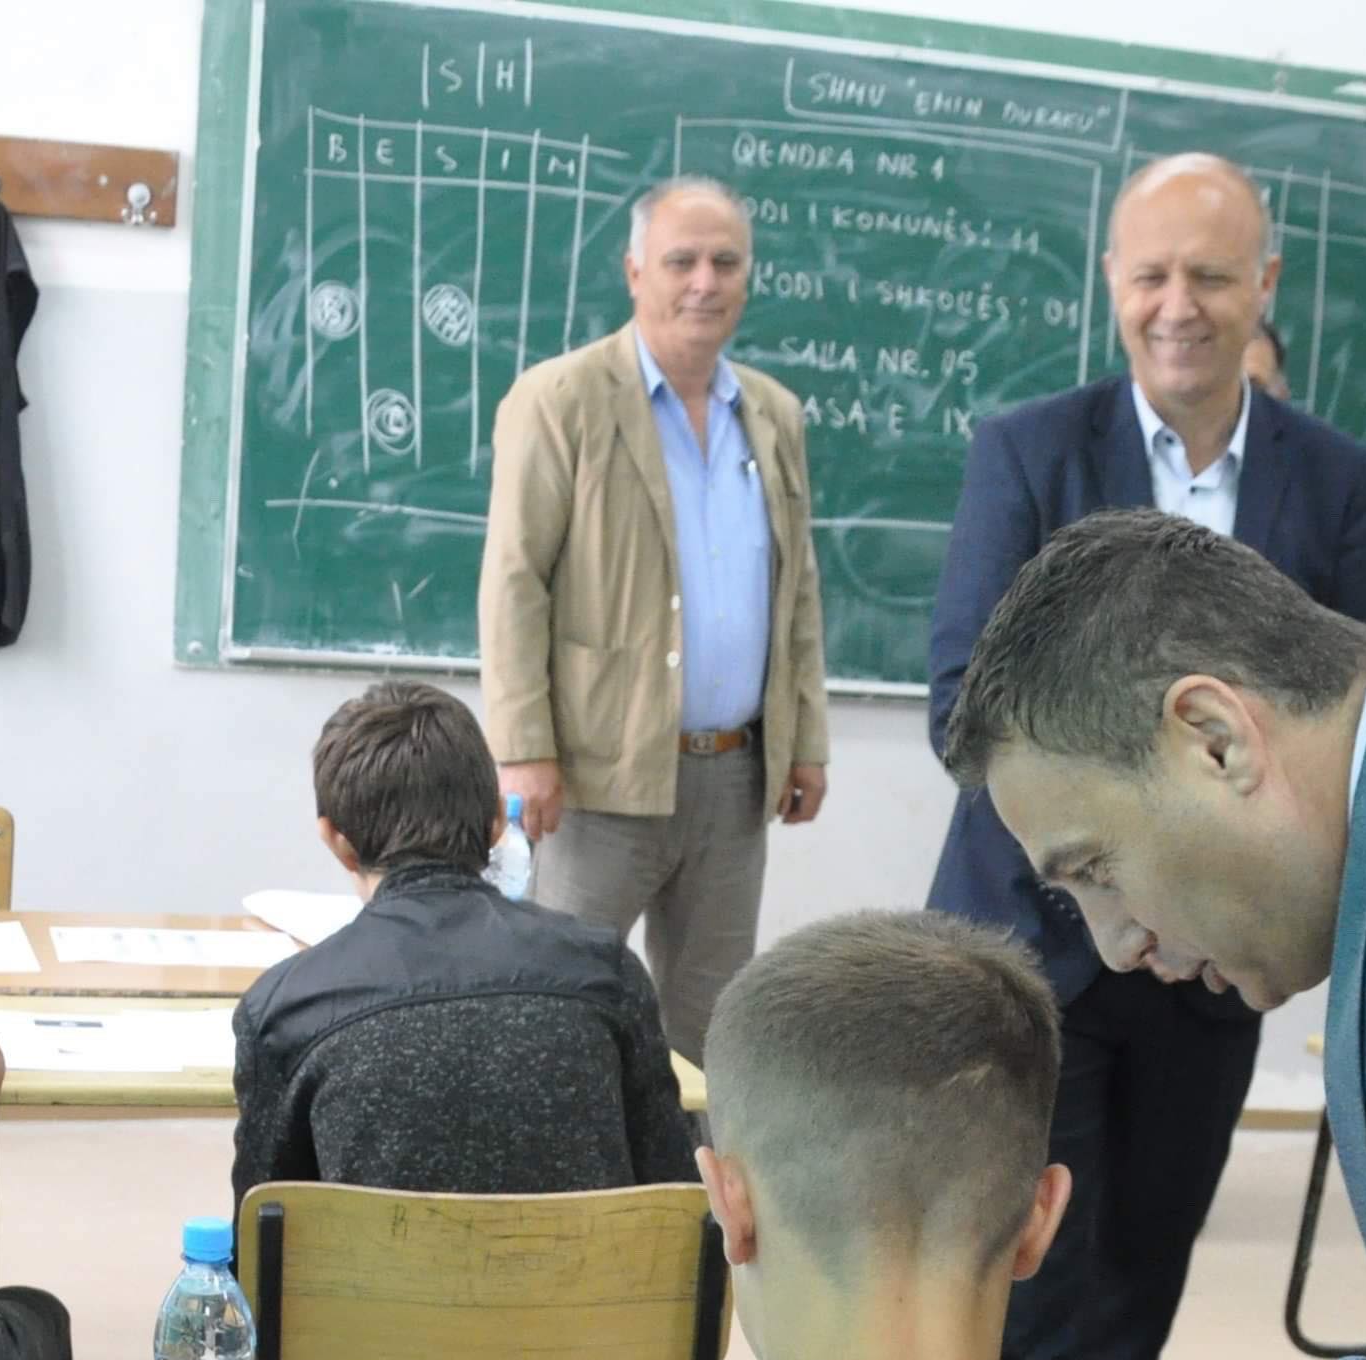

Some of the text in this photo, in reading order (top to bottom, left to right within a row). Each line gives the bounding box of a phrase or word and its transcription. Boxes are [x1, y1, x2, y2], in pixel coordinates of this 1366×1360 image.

[732, 129, 854, 176] QENDRA
[876, 151, 918, 179] NR
[742, 195, 789, 226] ODI
[1010, 227, 1040, 256] 11
[1042, 297, 1079, 329] 01
[802, 393, 868, 436] ASA
